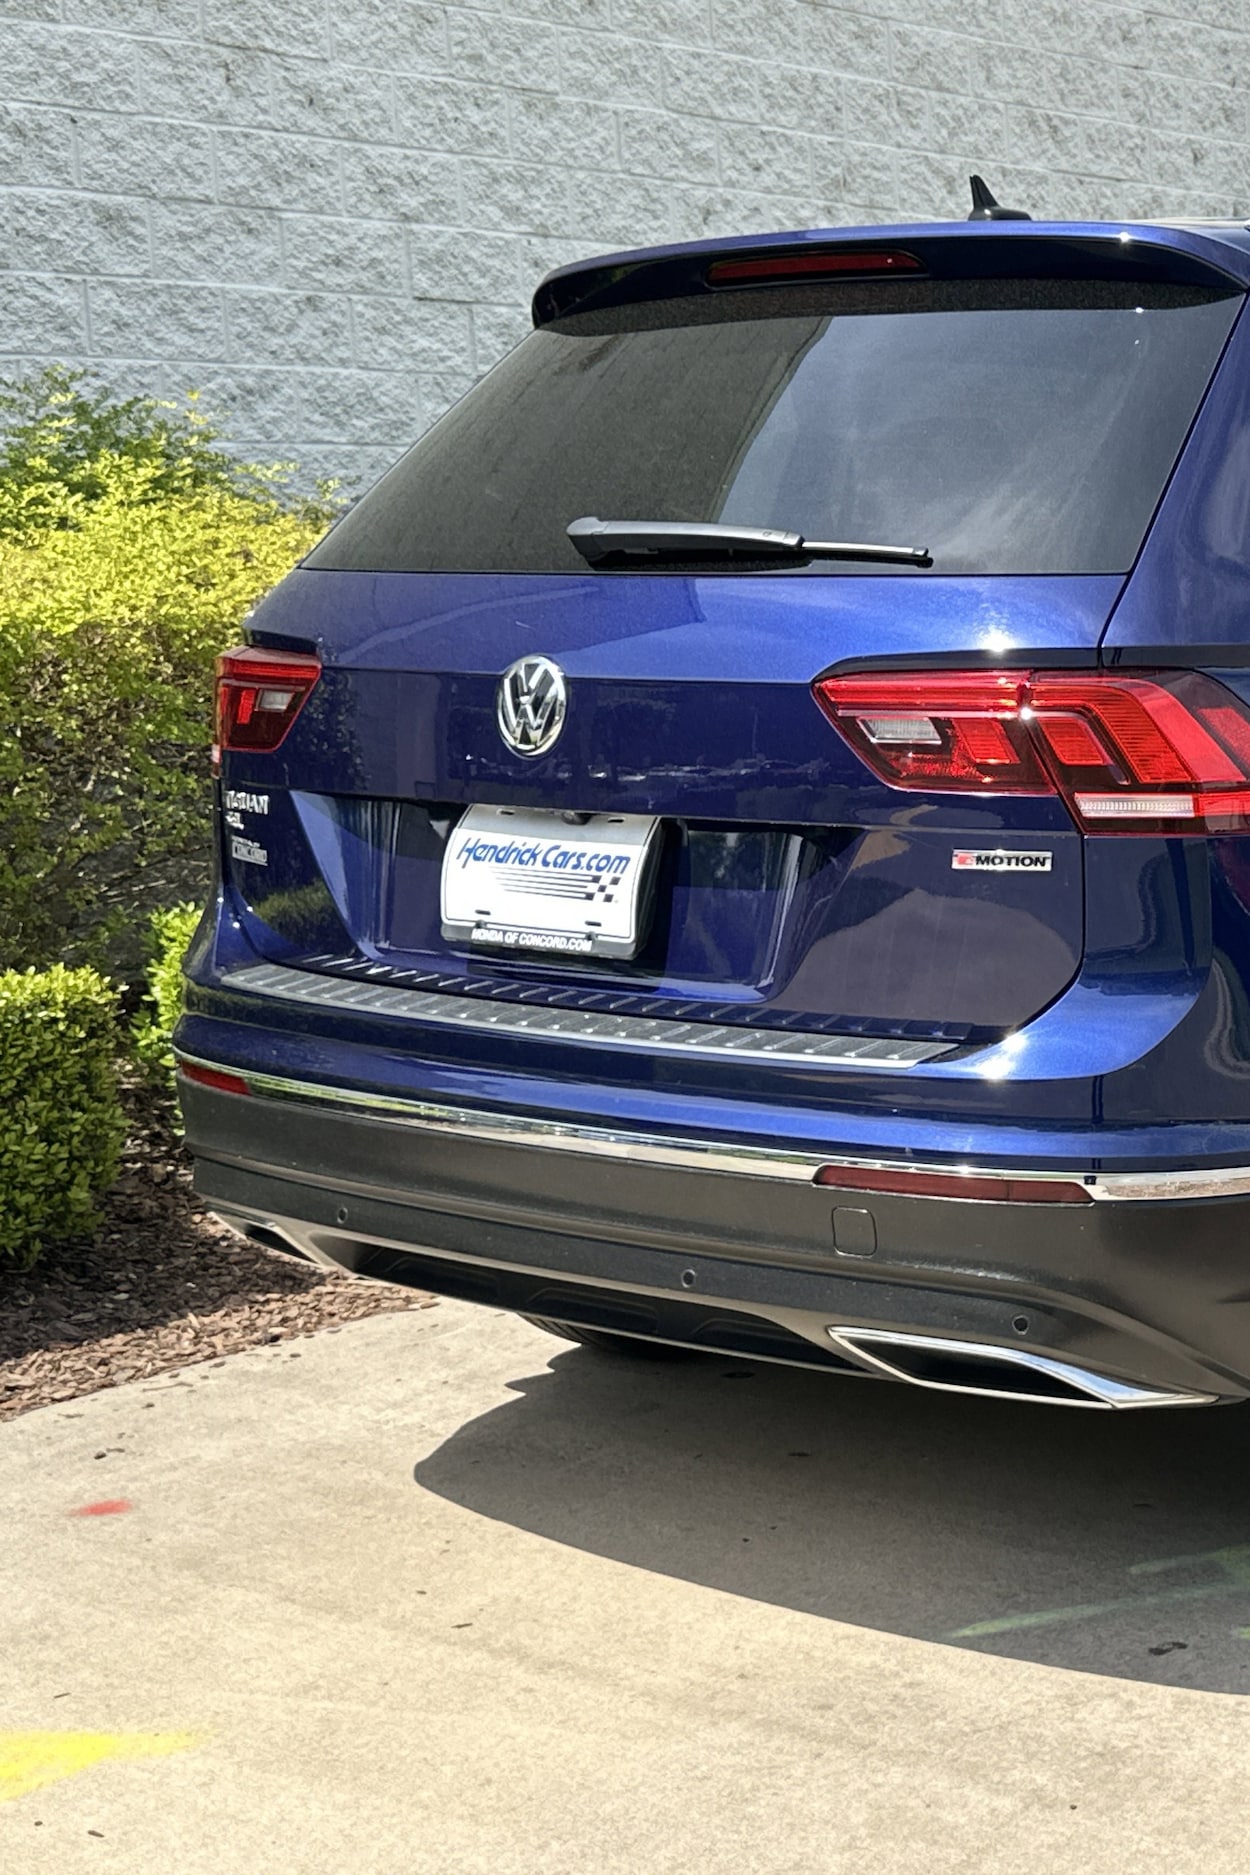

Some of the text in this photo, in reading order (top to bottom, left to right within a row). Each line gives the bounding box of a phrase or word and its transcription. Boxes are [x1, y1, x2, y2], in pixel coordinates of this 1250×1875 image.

[471, 928, 592, 951] HONDA OF CONCORD.COM
